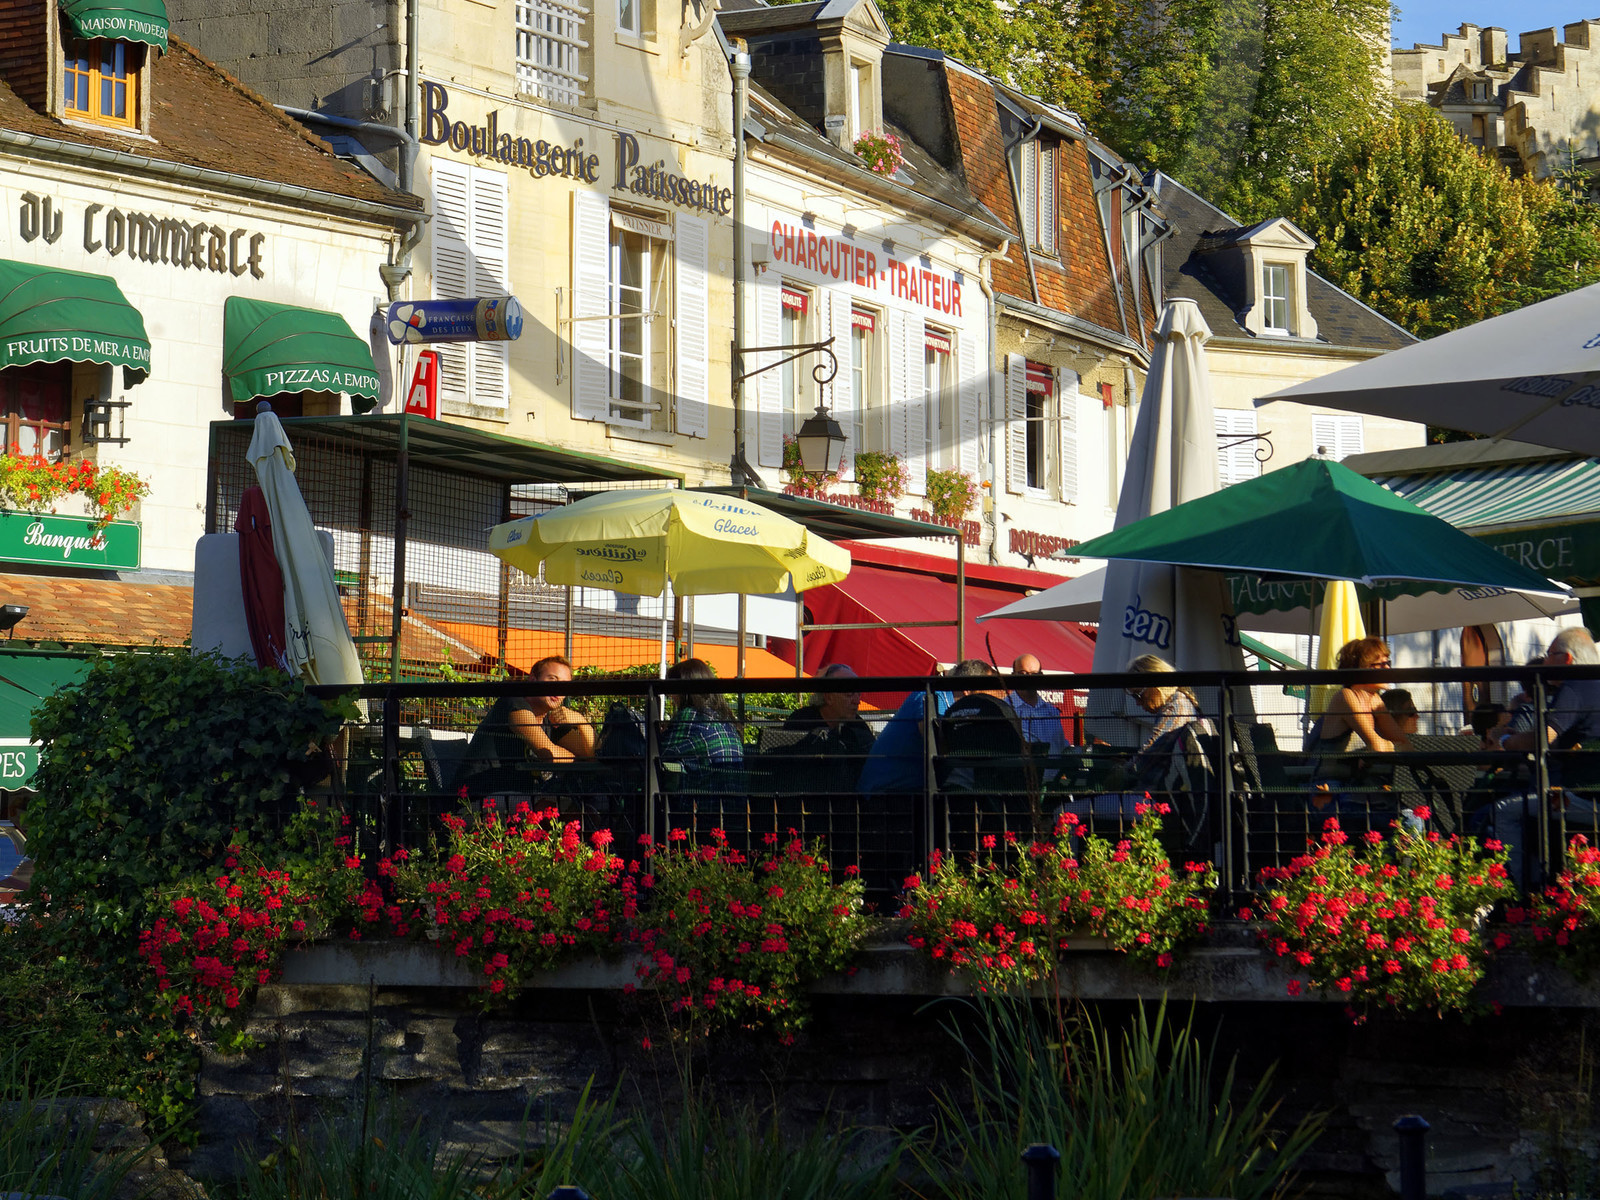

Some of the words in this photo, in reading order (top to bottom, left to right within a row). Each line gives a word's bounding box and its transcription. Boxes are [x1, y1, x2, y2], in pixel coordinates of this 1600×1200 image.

[81, 17, 127, 31] MAISON
[420, 80, 600, 184] Boulangerie
[614, 131, 732, 215] Patisserie
[621, 215, 662, 236] PATISSIER
[771, 219, 877, 290] CHARCUTIER
[887, 258, 963, 318] TRAITEUR
[432, 326, 448, 334] DES
[452, 325, 473, 334] JEUX
[7, 337, 69, 357] FRUITS
[71, 337, 92, 352] DE
[94, 340, 120, 357] MER
[122, 344, 131, 359] A
[265, 369, 330, 386] PIZZAS
[332, 371, 342, 385] A
[714, 518, 760, 537] Glaces
[0, 751, 26, 778] ES
